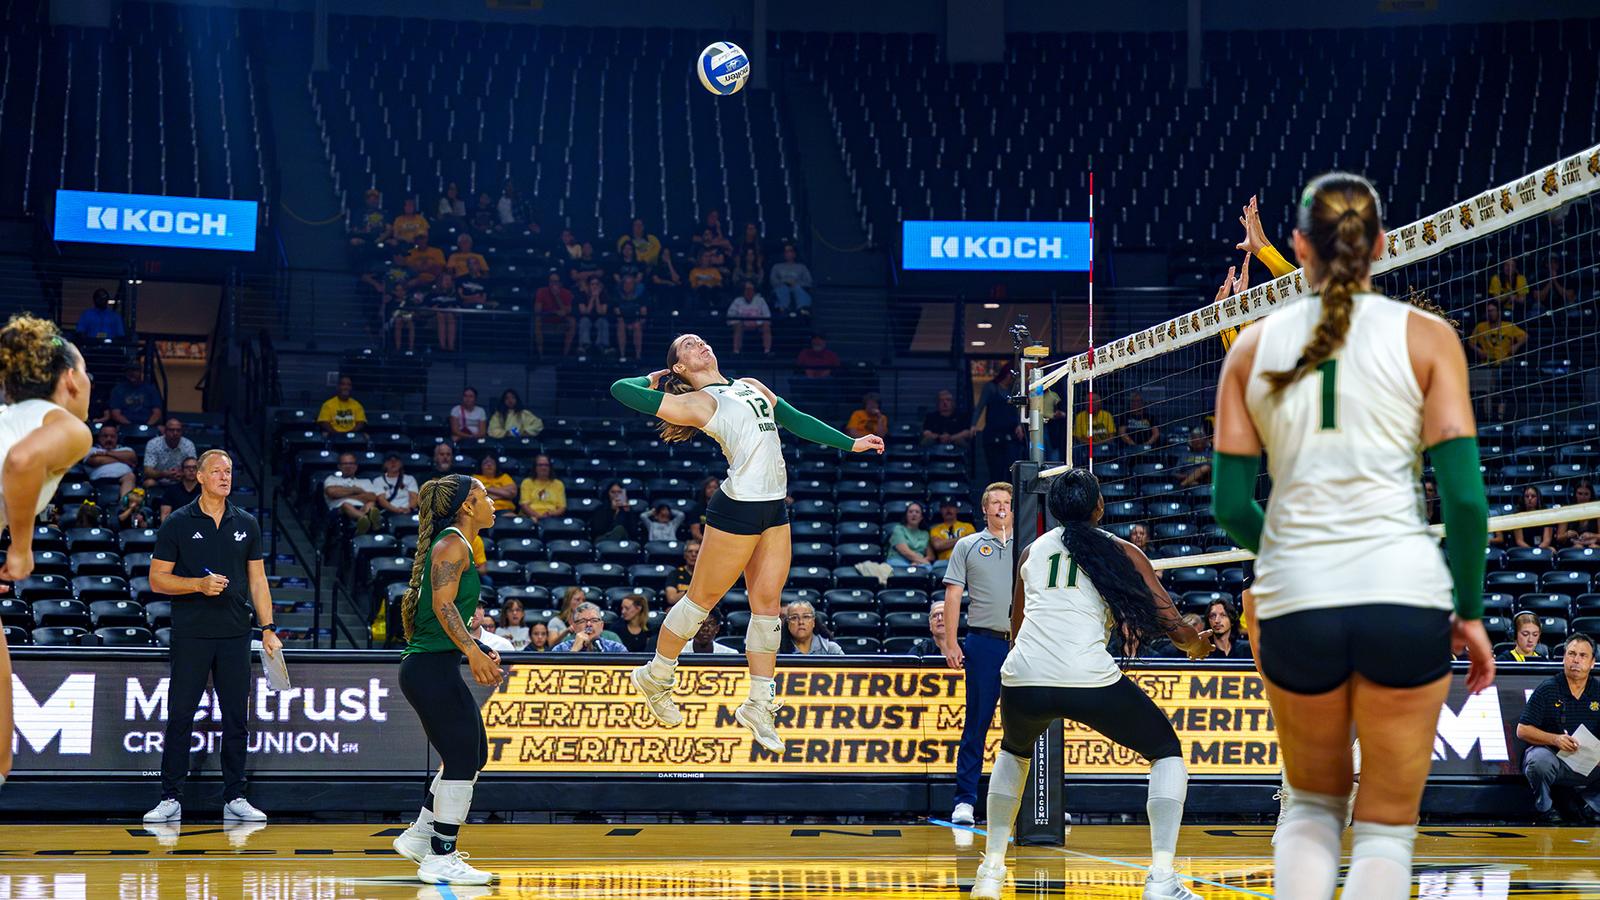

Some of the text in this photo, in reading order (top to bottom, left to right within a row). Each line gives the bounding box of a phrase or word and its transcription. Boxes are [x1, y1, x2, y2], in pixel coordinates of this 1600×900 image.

[1561, 169, 1582, 186] STATE
[1519, 188, 1537, 204] STATE
[123, 208, 227, 236] KOCH
[1479, 205, 1496, 221] STATE
[964, 236, 1062, 258] KOCH
[1315, 356, 1340, 432] 1
[746, 397, 770, 418] 12
[1045, 551, 1079, 590] 11
[525, 669, 744, 696] MERITUST
[485, 701, 707, 729] MERITRUT
[715, 704, 929, 730] MRITRUST
[247, 730, 339, 753] UNION
[520, 737, 742, 764] MERITRUST
